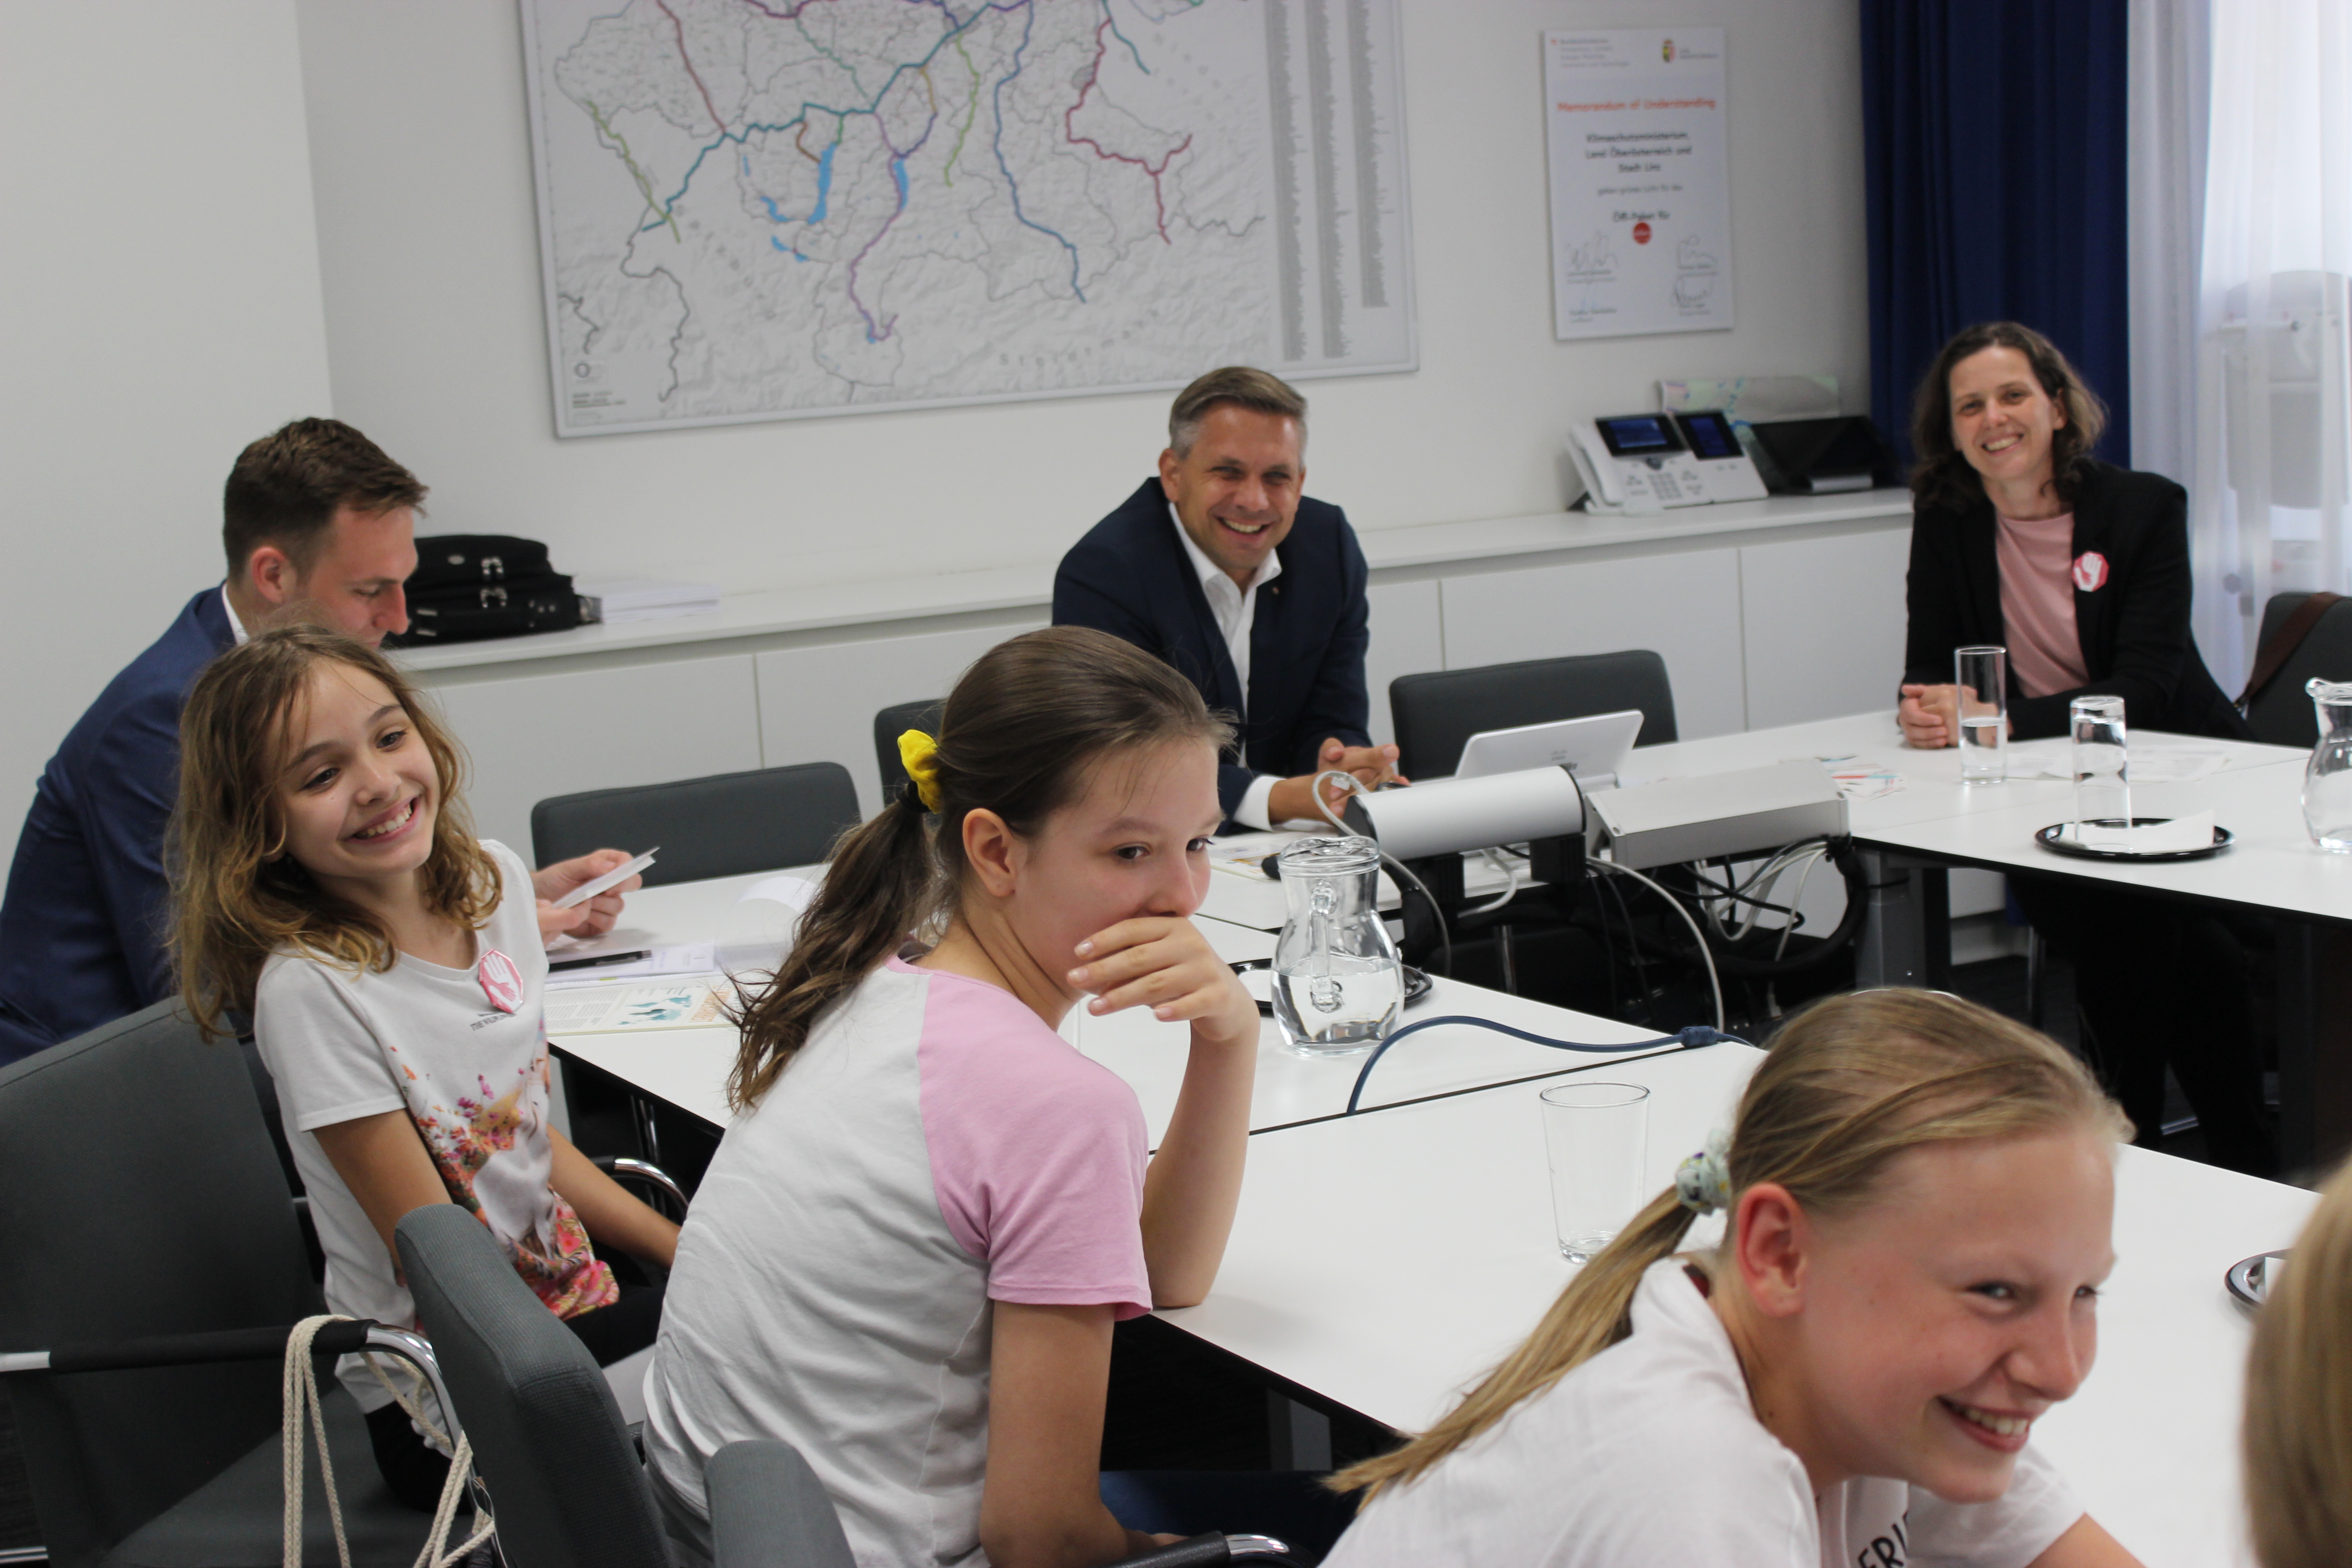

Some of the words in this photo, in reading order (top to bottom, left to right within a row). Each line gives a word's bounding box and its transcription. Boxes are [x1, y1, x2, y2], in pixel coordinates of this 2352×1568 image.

[1557, 100, 1626, 112] Memorandum
[1629, 98, 1640, 110] of
[1644, 97, 1716, 111] Understanding
